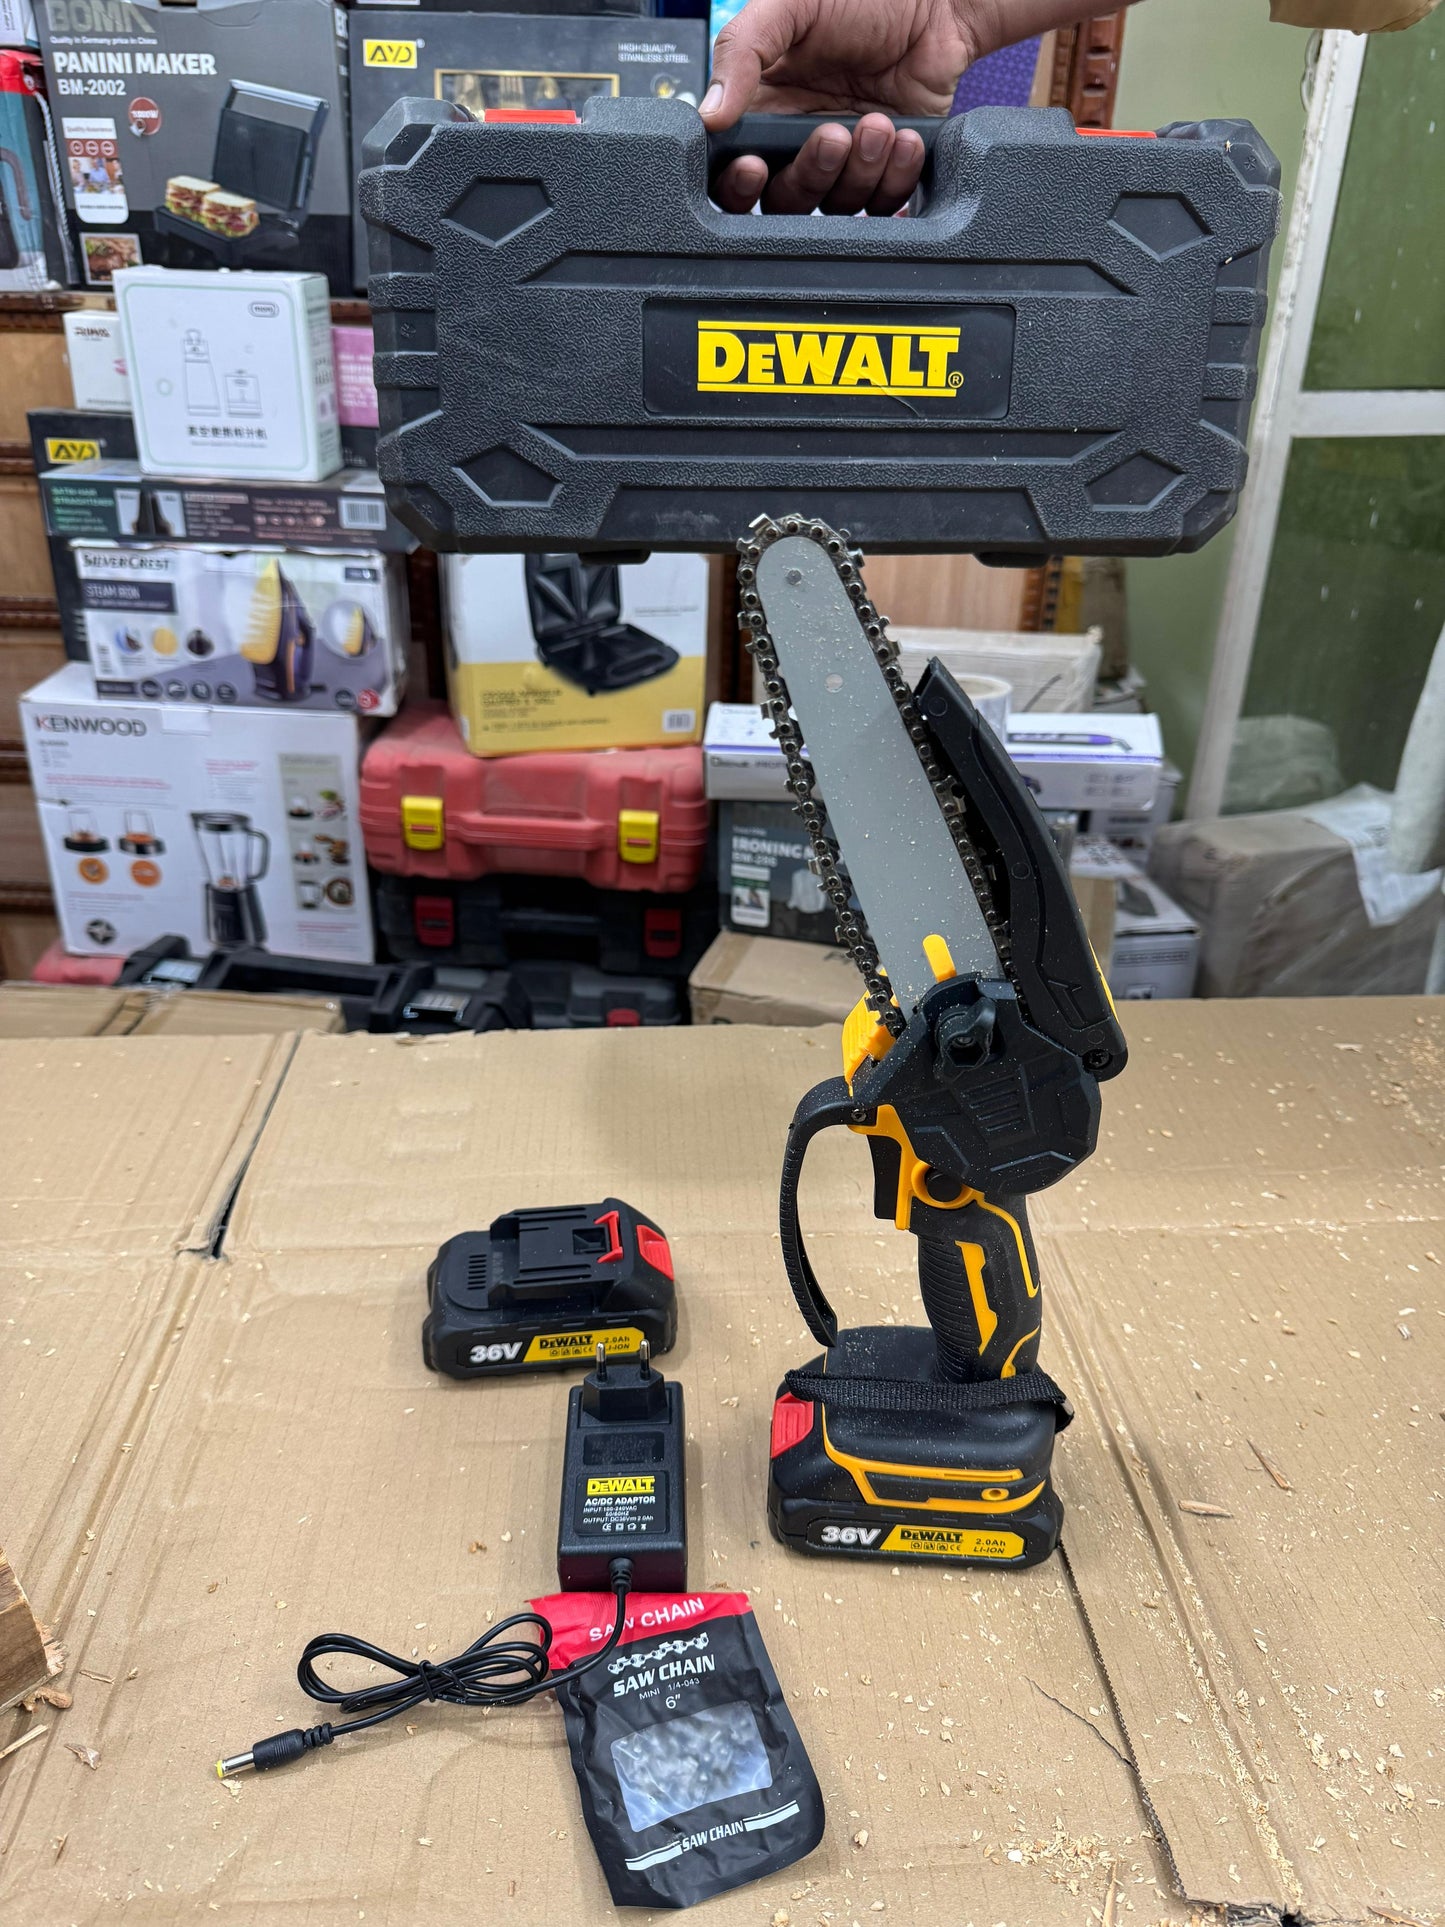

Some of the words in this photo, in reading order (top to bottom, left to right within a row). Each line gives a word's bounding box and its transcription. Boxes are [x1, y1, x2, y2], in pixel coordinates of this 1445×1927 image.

[618, 43, 639, 52] HIGH
[640, 43, 677, 53] QUALITY
[52, 52, 132, 75] PANINI
[135, 52, 217, 76] MAKER
[663, 53, 689, 64] STEEL
[58, 79, 127, 96] BM-2002
[86, 585, 117, 598] STEAM
[118, 587, 141, 600] IRON
[35, 715, 147, 737] KENWOOD
[603, 1336, 630, 1344] 2.0Ah
[605, 1343, 630, 1351] I-ION
[470, 1342, 523, 1364] 36V
[584, 1497, 613, 1507] AC/DC
[615, 1495, 656, 1505] ADAPTOR
[821, 1525, 882, 1545] 36V
[975, 1538, 1006, 1547] 2.0Ah
[973, 1546, 1005, 1555] LI-ION
[641, 1597, 704, 1627] CHAIN
[613, 1668, 655, 1698] SAW
[659, 1653, 716, 1681] CHAIN
[639, 1688, 660, 1700] MINI
[667, 1678, 700, 1691] 1/4-043
[681, 1829, 708, 1852] SAW
[709, 1820, 744, 1844] CHAIN
